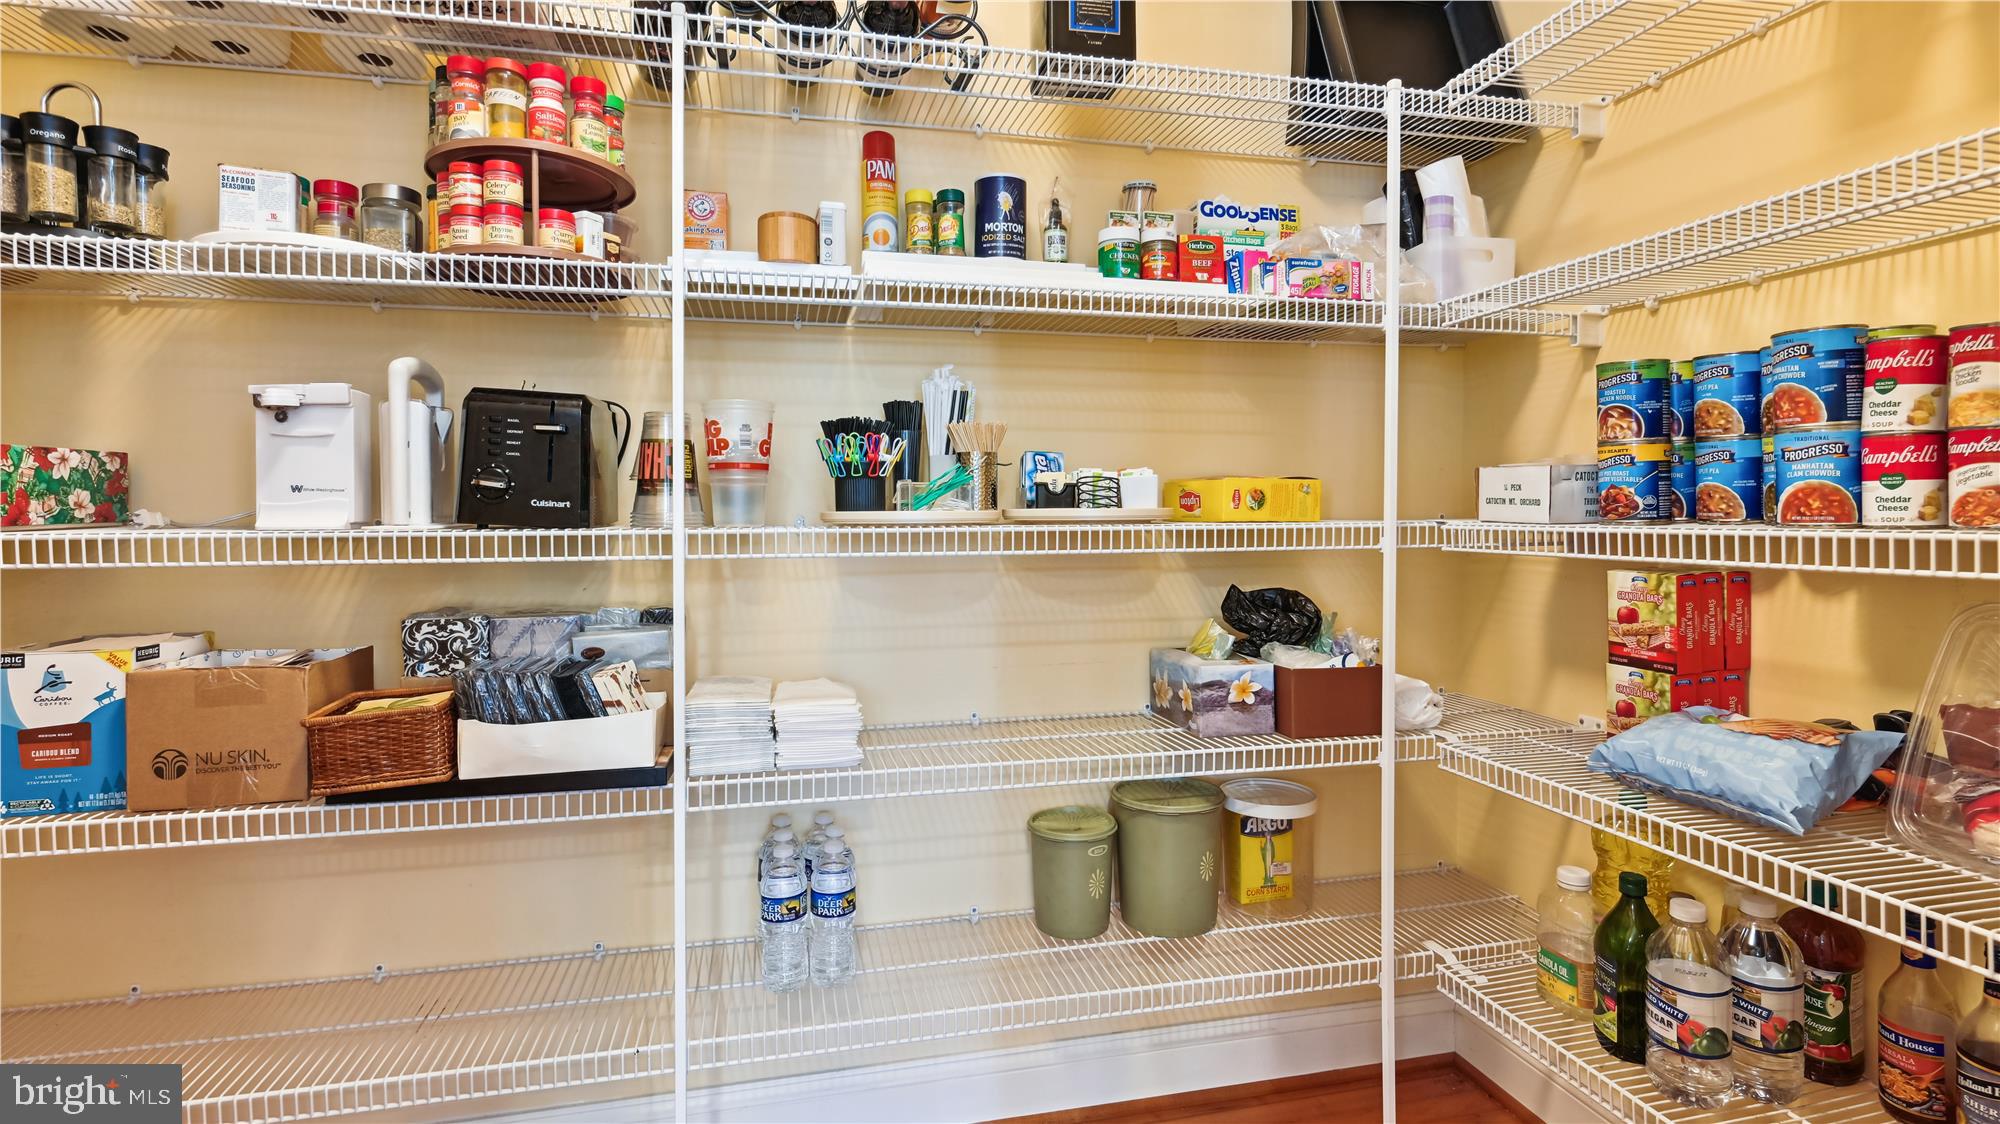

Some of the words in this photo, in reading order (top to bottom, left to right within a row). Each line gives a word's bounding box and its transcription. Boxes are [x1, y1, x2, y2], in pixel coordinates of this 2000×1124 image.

[29, 128, 66, 140] Oregano
[867, 160, 896, 181] PAM
[221, 174, 256, 185] SEAFOOD
[221, 182, 256, 192] SEASONING
[485, 181, 509, 190] Celery
[488, 188, 507, 196] Seed
[705, 227, 724, 235] Soda
[984, 221, 1025, 234] MORTON
[553, 229, 574, 240] Curry
[981, 233, 1012, 242] IODIZED
[1246, 237, 1261, 245] Bags
[1109, 252, 1140, 261] CHICKEN
[1192, 259, 1213, 267] BEEF
[1598, 372, 1637, 389] PROGRESSO
[1604, 388, 1626, 396] ROASTED
[1868, 400, 1902, 409] Cheddar
[1869, 409, 1898, 417] Cheese
[1784, 443, 1843, 461] PROGRESSO
[1791, 462, 1834, 470] MANHATTAN
[1786, 470, 1804, 478] CLAM
[1804, 469, 1841, 477] CHOWDER
[1955, 469, 1994, 487] Vegetable
[1510, 483, 1522, 491] PECK
[530, 499, 571, 508] Cuisinart
[1485, 497, 1506, 505] CATOCTIN
[1520, 498, 1541, 506] ORCHARD
[1875, 495, 1912, 503] Cheddar
[1616, 591, 1644, 602] GRANOLA
[1646, 594, 1664, 605] BARS
[1685, 601, 1694, 618] BARS
[1708, 598, 1717, 616] BARS
[1735, 597, 1744, 614] BARS
[1686, 619, 1694, 649] GRANOLA
[1709, 617, 1717, 646] GRANOLA
[1735, 617, 1744, 645] GRANOLA
[136, 647, 159, 657] KEURIG
[105, 656, 123, 670] PACK
[109, 651, 128, 666] VALUE
[33, 695, 73, 703] Caribou
[1616, 683, 1641, 698] GRANOLA
[1642, 690, 1660, 704] BARS
[31, 749, 58, 757] CARIBOU
[60, 747, 80, 756] BLEND
[195, 751, 223, 767] NU
[195, 766, 230, 775] DISCOVER
[230, 765, 244, 773] THE
[245, 763, 261, 772] BEST
[1244, 817, 1289, 833] ARGO
[1246, 888, 1265, 897] CORN
[1266, 885, 1290, 896] STARCH
[817, 899, 843, 908] DEER
[761, 911, 783, 922] PARK
[817, 907, 844, 917] PARK
[1558, 965, 1570, 979] OIL
[1658, 998, 1686, 1021] WHITE
[1739, 998, 1769, 1018] WHITE
[1898, 1035, 1936, 1054] House
[1958, 1074, 1993, 1095] Holland
